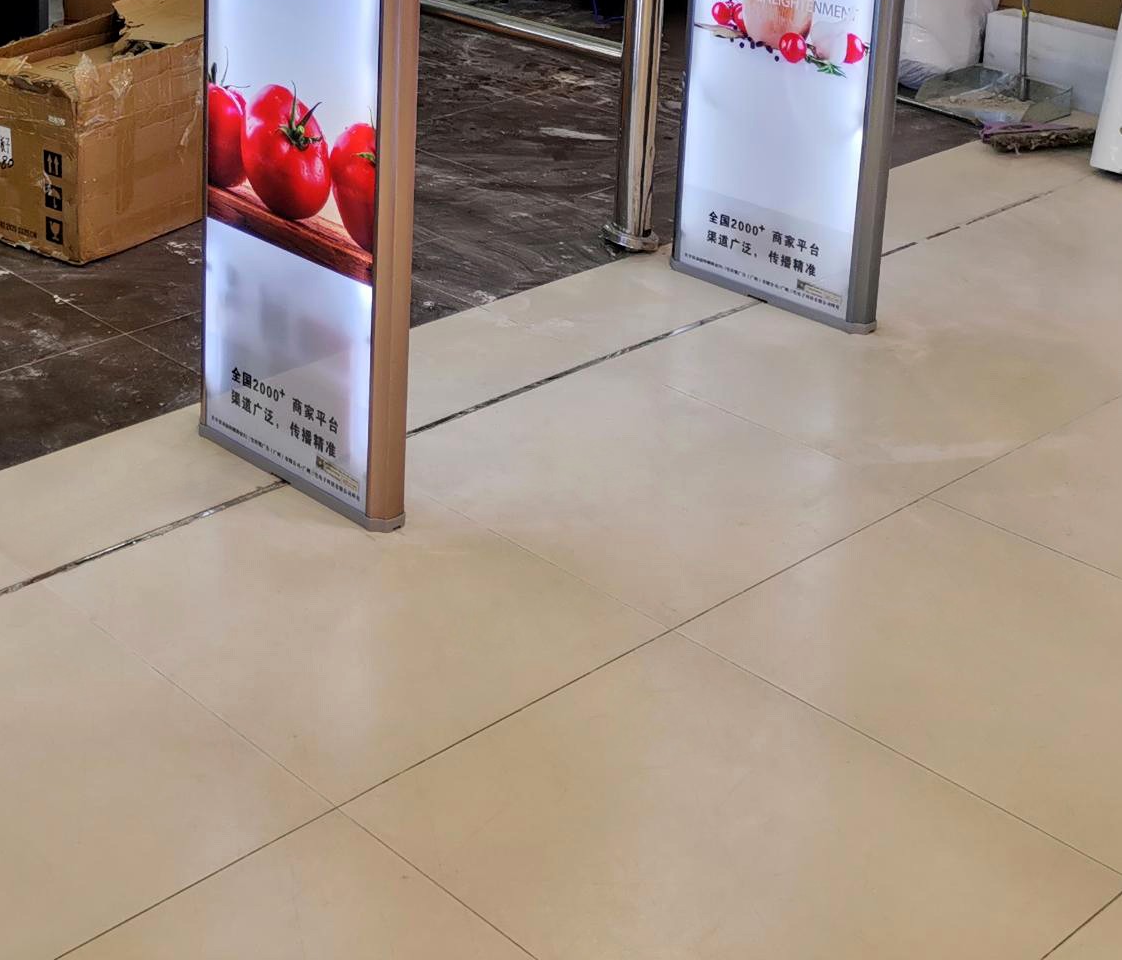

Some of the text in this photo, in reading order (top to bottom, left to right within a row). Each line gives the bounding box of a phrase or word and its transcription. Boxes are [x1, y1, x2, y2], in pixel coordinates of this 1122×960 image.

[772, 230, 820, 258] 商家平台
[768, 249, 817, 278] 传播精准
[292, 397, 339, 435] 商家平台
[289, 421, 336, 459] 传播精准
